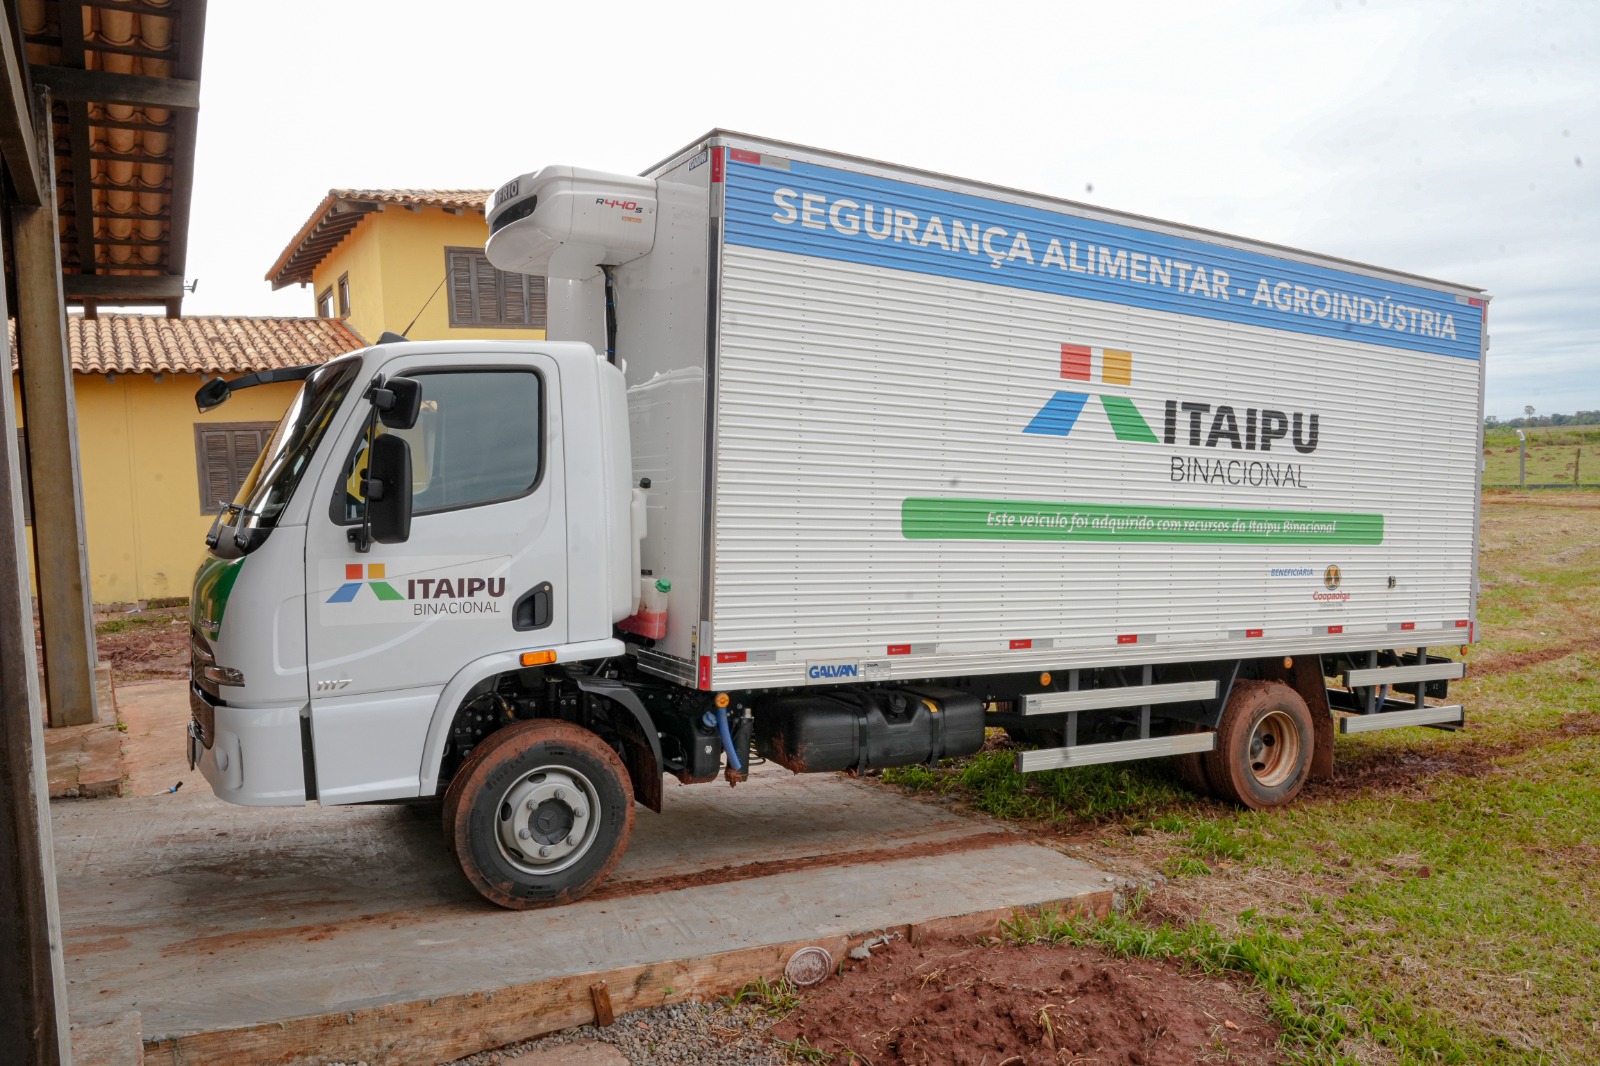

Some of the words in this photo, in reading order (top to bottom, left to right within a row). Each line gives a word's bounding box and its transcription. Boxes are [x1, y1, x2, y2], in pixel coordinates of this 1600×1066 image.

[771, 187, 1034, 269] SEGURANÇA
[1040, 238, 1230, 301] ALIMENTAR
[1251, 278, 1457, 341] AGROINDÚSTRIA
[1163, 399, 1319, 454] ITAIPU
[1170, 456, 1308, 489] BINACIONAL
[986, 511, 1016, 527] Este
[1019, 511, 1068, 528] veículo
[1067, 512, 1090, 533] foi
[1091, 513, 1154, 534] adquirido
[1157, 518, 1181, 531] com
[1183, 519, 1230, 532] recursos
[1232, 517, 1246, 532] da
[1249, 519, 1281, 537] Itaipu
[1283, 520, 1337, 533] Binacional
[407, 577, 506, 600] ITAIPU
[413, 601, 501, 616] BINACIONAL
[808, 663, 858, 679] GALVAN
